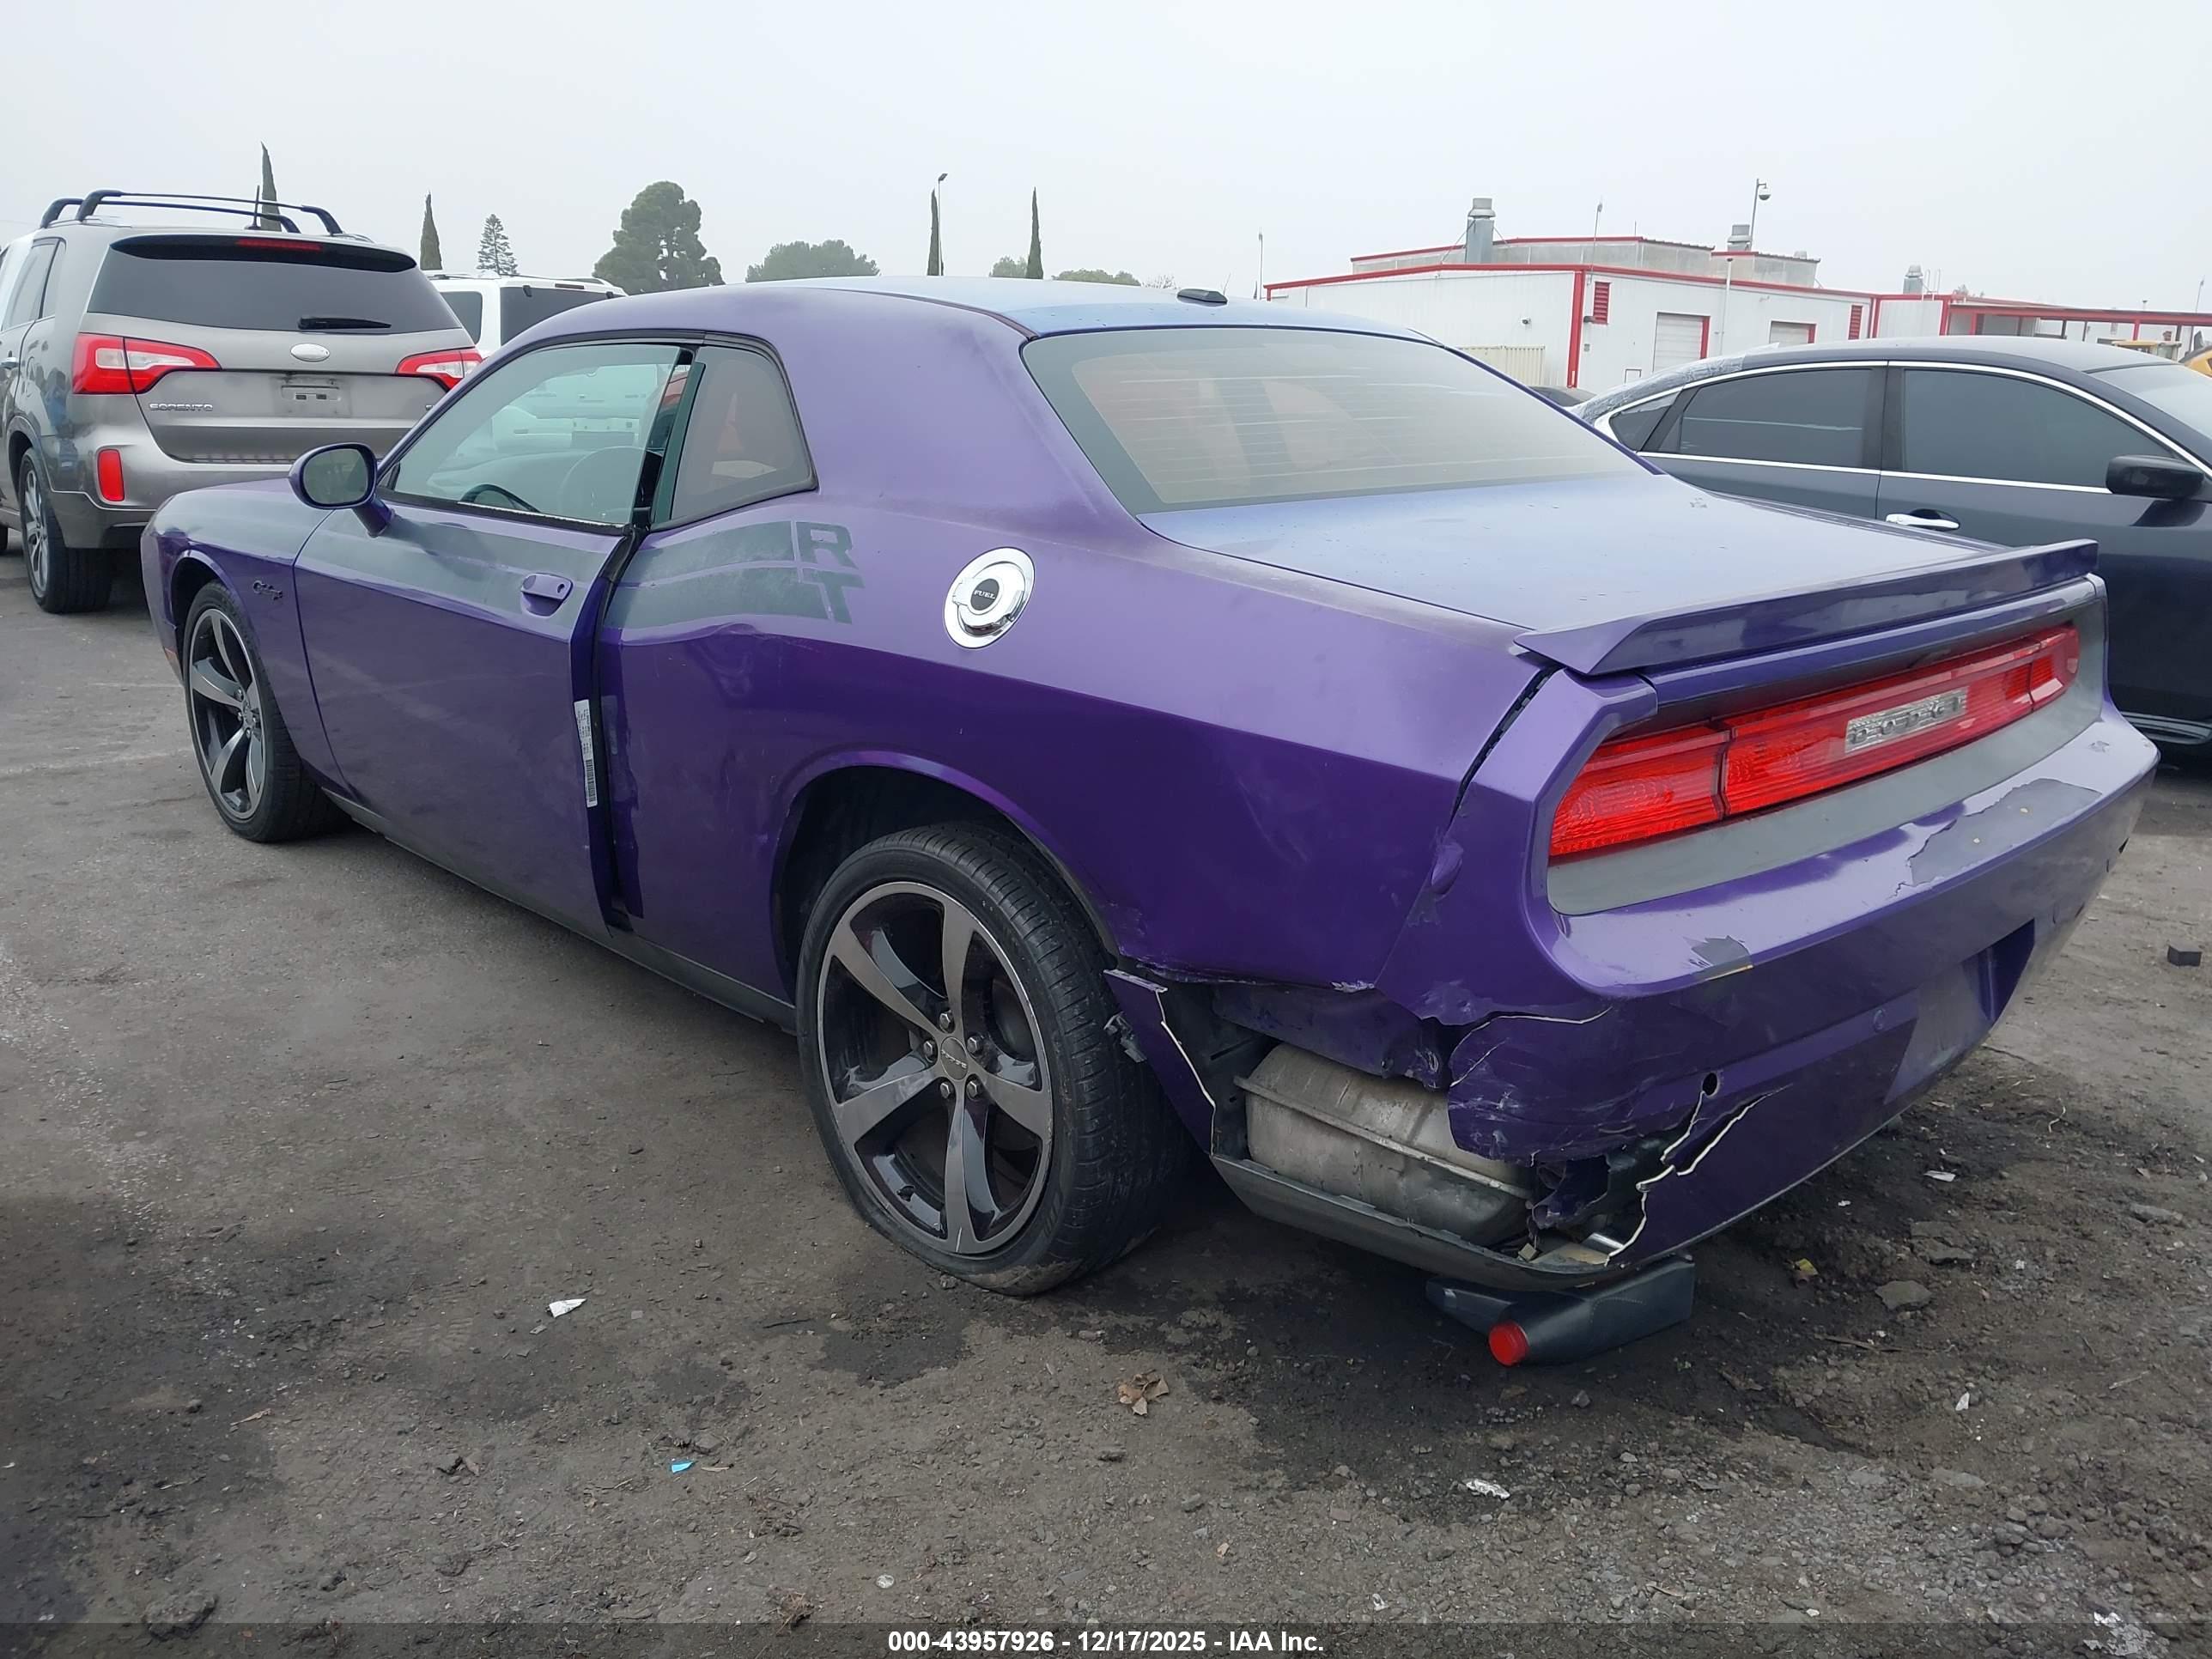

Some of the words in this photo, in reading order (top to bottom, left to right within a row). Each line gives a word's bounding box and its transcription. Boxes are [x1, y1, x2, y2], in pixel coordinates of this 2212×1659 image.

[149, 403, 214, 412] SORENTO
[795, 521, 860, 570] R
[803, 568, 866, 625] T
[974, 589, 996, 599] FUEL
